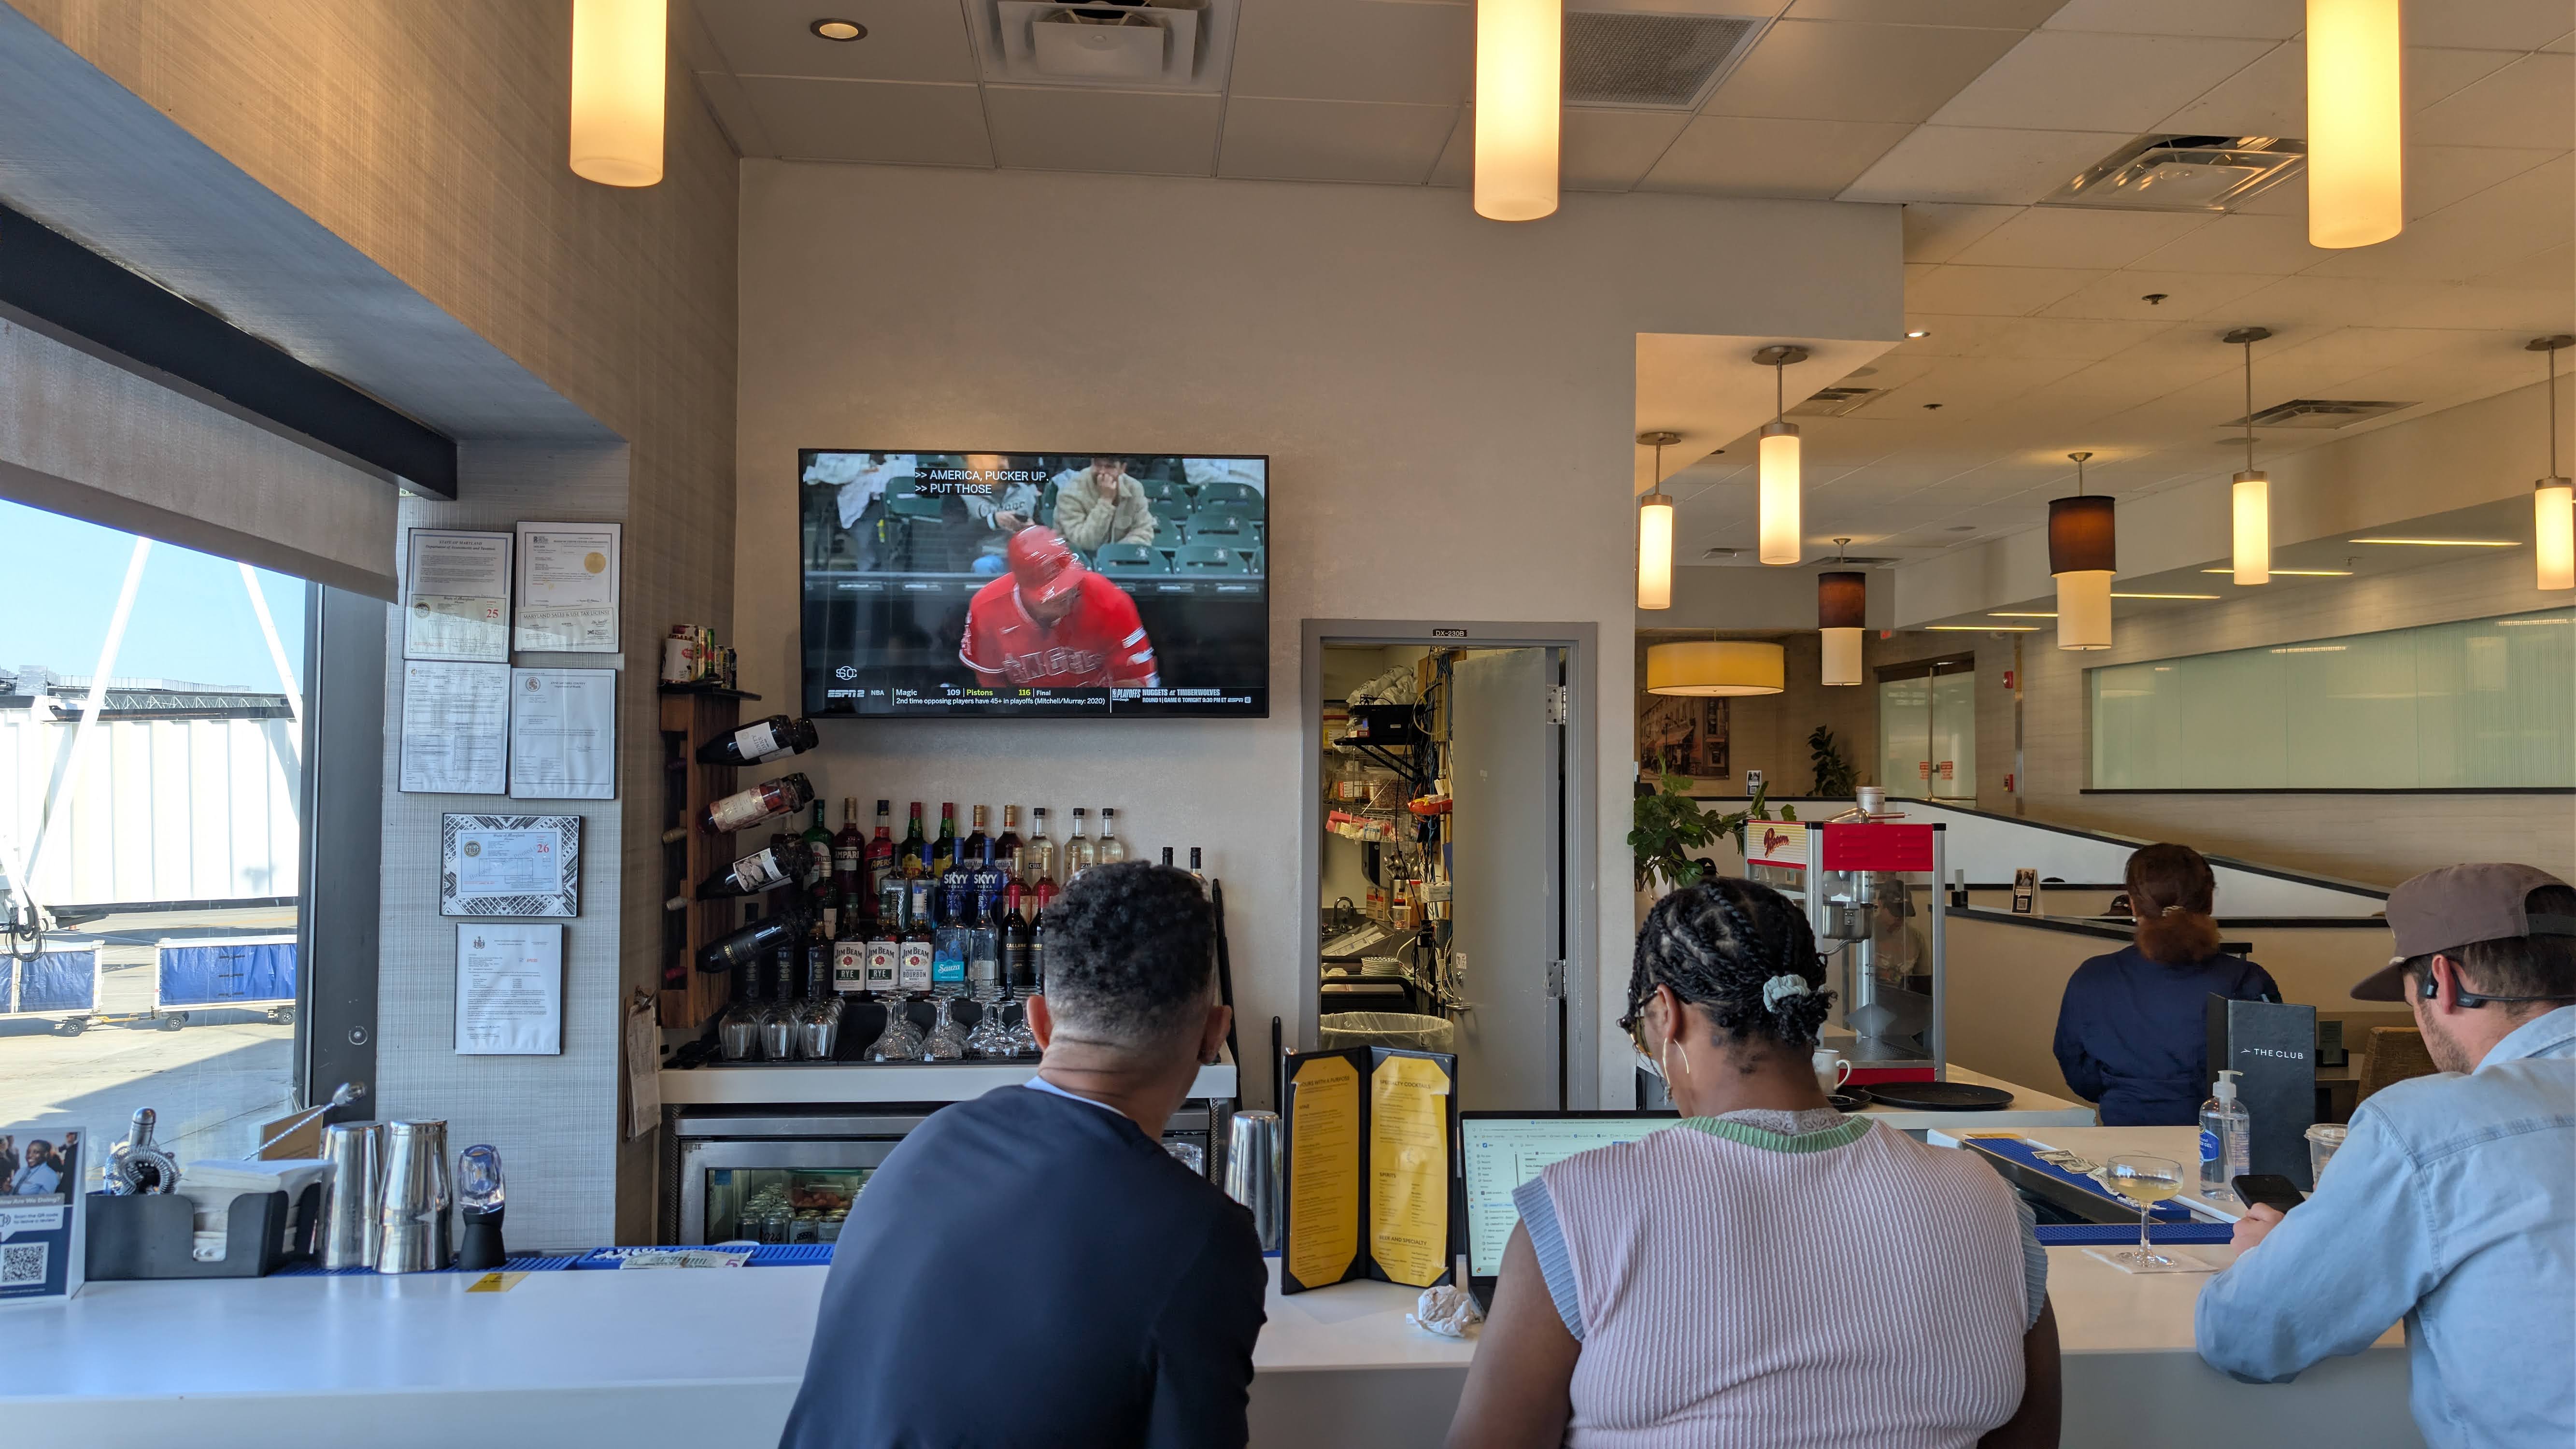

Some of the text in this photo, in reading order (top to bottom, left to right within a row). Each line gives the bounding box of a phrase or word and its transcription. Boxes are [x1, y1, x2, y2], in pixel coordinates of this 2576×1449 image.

[930, 470, 982, 482] AMERICA,
[985, 471, 1028, 481] PUCKER
[1031, 471, 1049, 481] UP.
[930, 483, 952, 493] PUT
[954, 484, 992, 494] THOSE
[486, 609, 499, 618] 25
[1117, 689, 1141, 698] PLAYOFFS
[1764, 827, 1790, 858] Popcorn
[537, 844, 549, 853] 26
[835, 850, 859, 859] AMPARI
[944, 874, 968, 884] SKYY
[974, 874, 997, 884] SKYY
[835, 947, 862, 959] JIM BEAM
[868, 946, 895, 959] JIM BEAM
[902, 947, 929, 959] JIM BEAM
[939, 964, 960, 974] Sauza
[2254, 1048, 2303, 1059] THE CLUB
